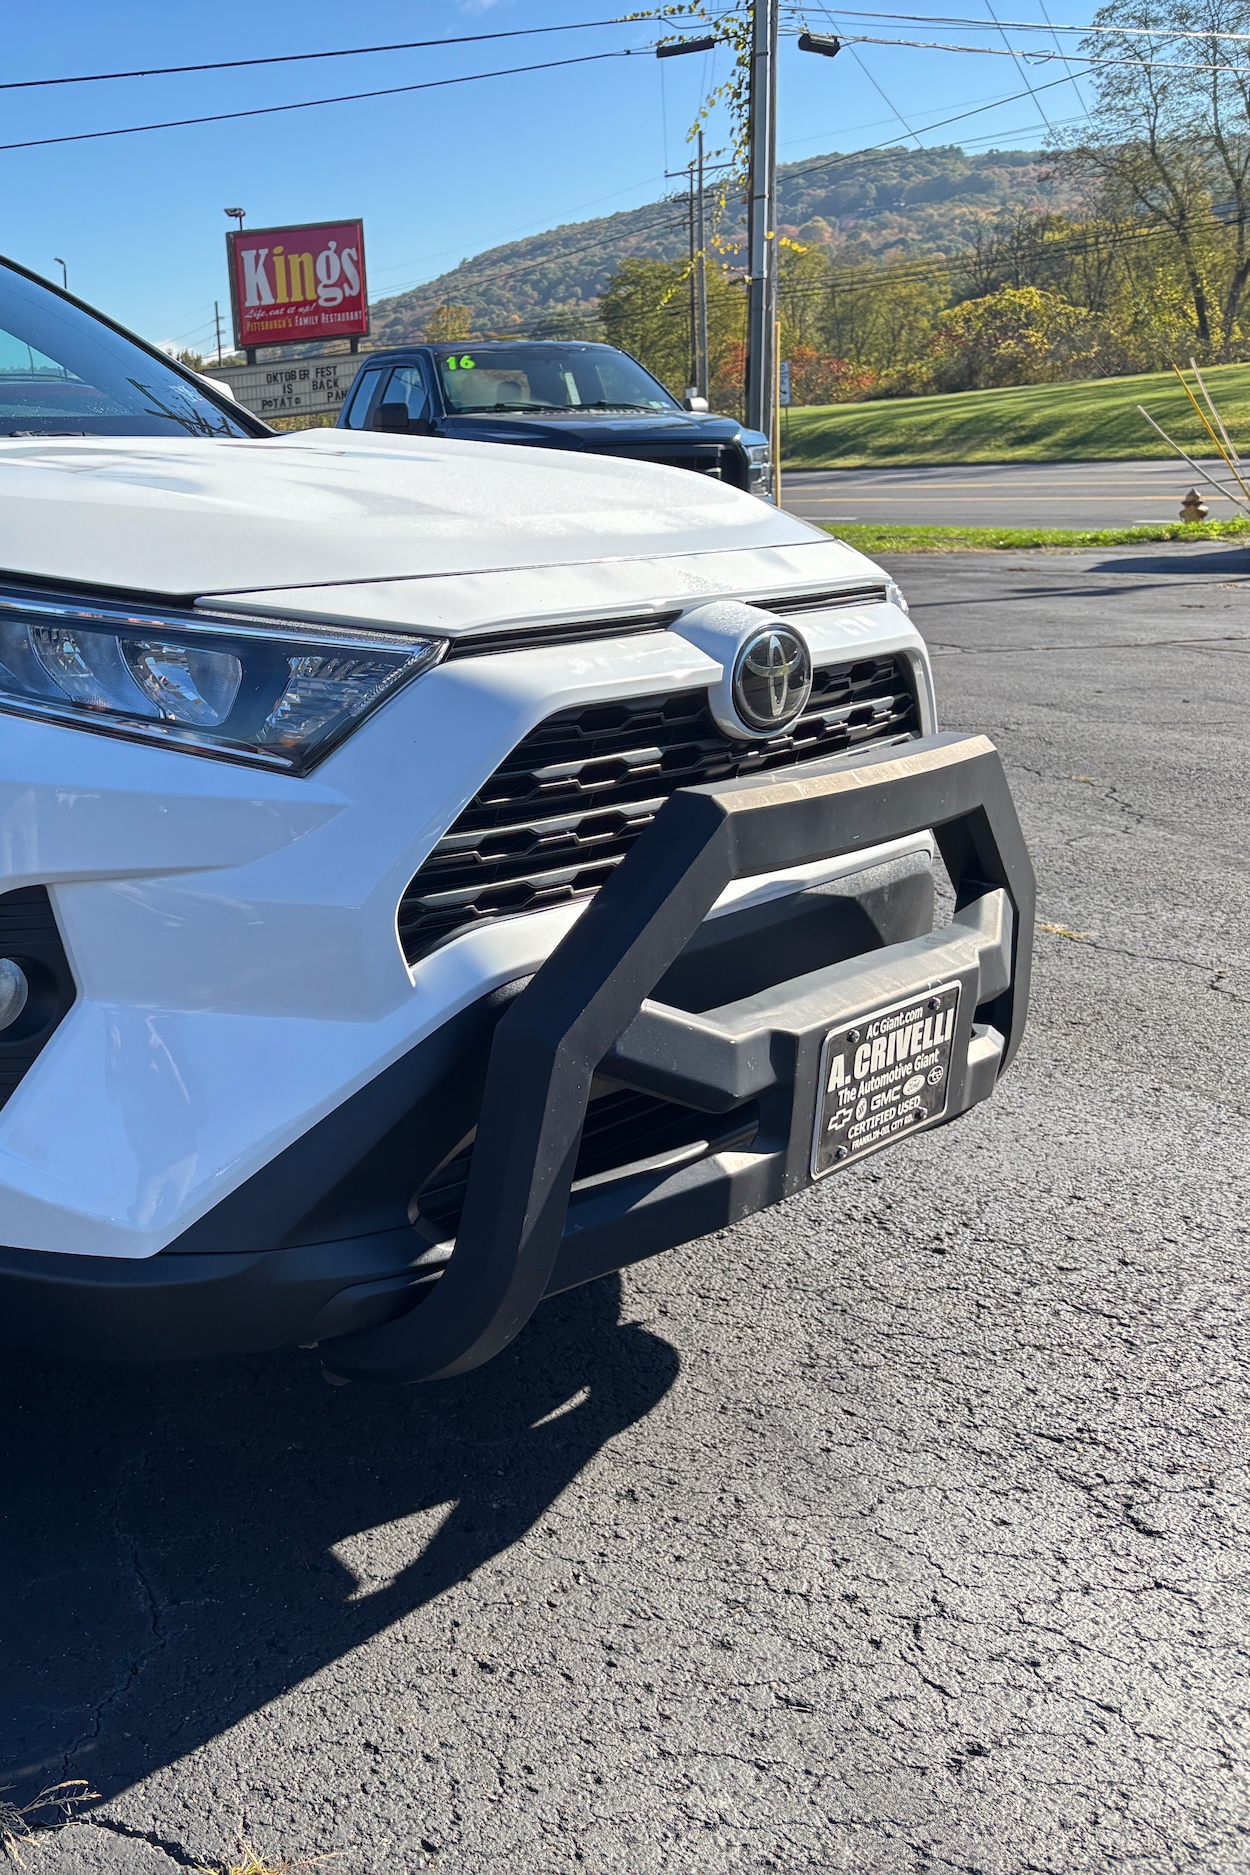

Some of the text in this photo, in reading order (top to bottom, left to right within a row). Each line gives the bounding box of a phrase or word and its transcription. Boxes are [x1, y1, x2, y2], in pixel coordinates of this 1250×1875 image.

[241, 240, 361, 307] Kings
[316, 366, 337, 378] FEST
[446, 355, 475, 370] 16
[283, 378, 340, 394] IS BACK
[827, 1008, 954, 1093] A. CRIVELLI
[838, 1048, 940, 1107] The Automotive Giant
[870, 1085, 902, 1111] GMC
[847, 1095, 921, 1140] CERTIFIED USED
[891, 1117, 905, 1131] CITY
